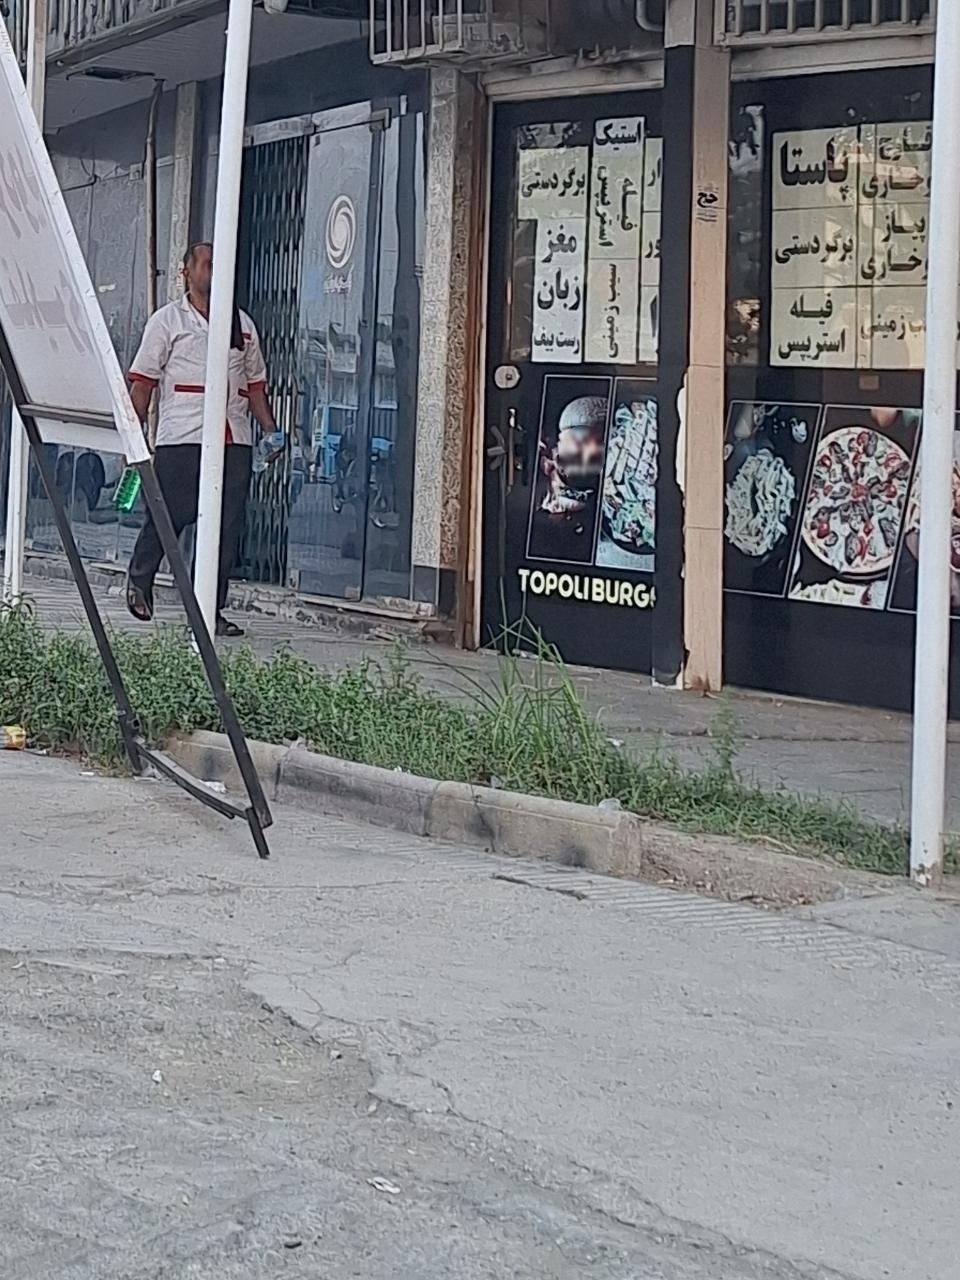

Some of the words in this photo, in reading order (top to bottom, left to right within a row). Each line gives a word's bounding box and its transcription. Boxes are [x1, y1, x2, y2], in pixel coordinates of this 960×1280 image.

[595, 121, 642, 150] استیک
[559, 167, 586, 197] برگر
[780, 136, 851, 202] پاستا
[521, 171, 559, 198] دستی
[541, 224, 577, 263] مغز
[775, 234, 820, 264] دستی
[821, 233, 854, 263] برگر
[537, 268, 581, 311] زبان
[790, 293, 833, 325] فیله
